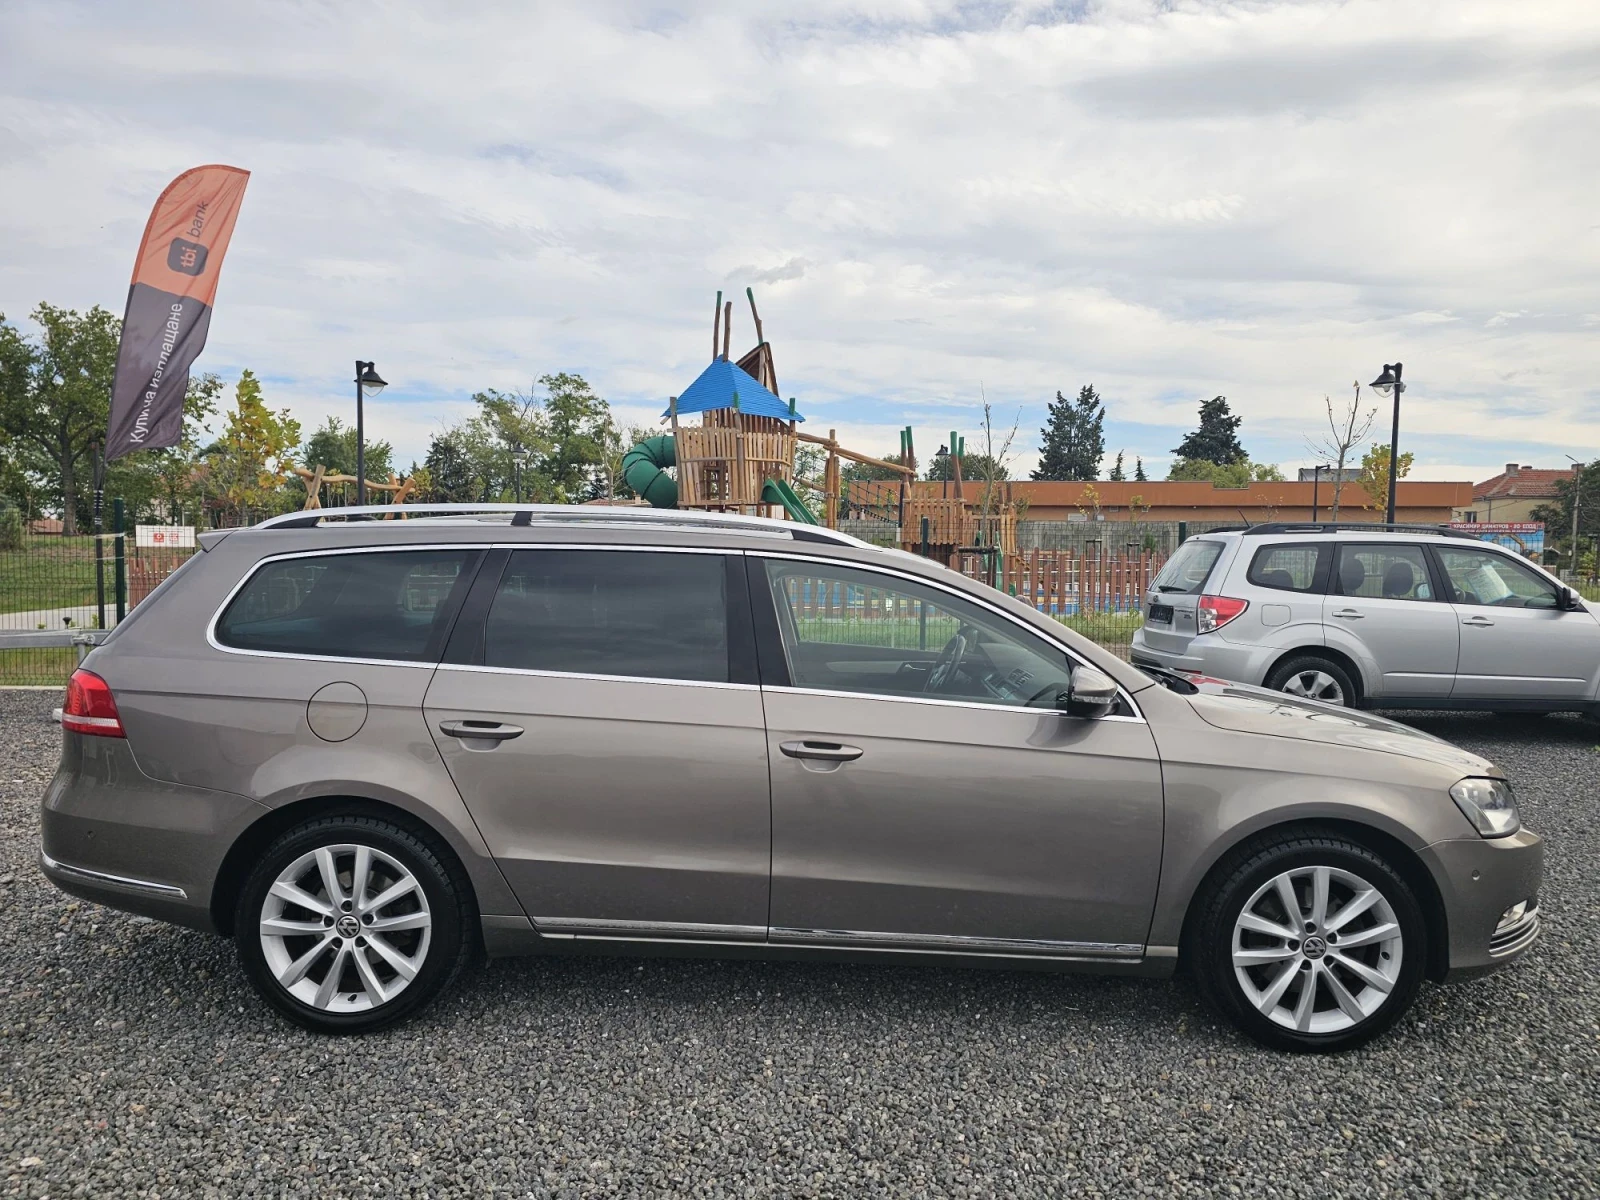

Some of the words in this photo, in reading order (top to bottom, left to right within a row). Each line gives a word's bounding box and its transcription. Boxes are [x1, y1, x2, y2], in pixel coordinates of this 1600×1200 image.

[186, 201, 209, 238] bank
[180, 246, 197, 268] tbi
[130, 408, 150, 443] Купи
[150, 303, 183, 388] изплащане
